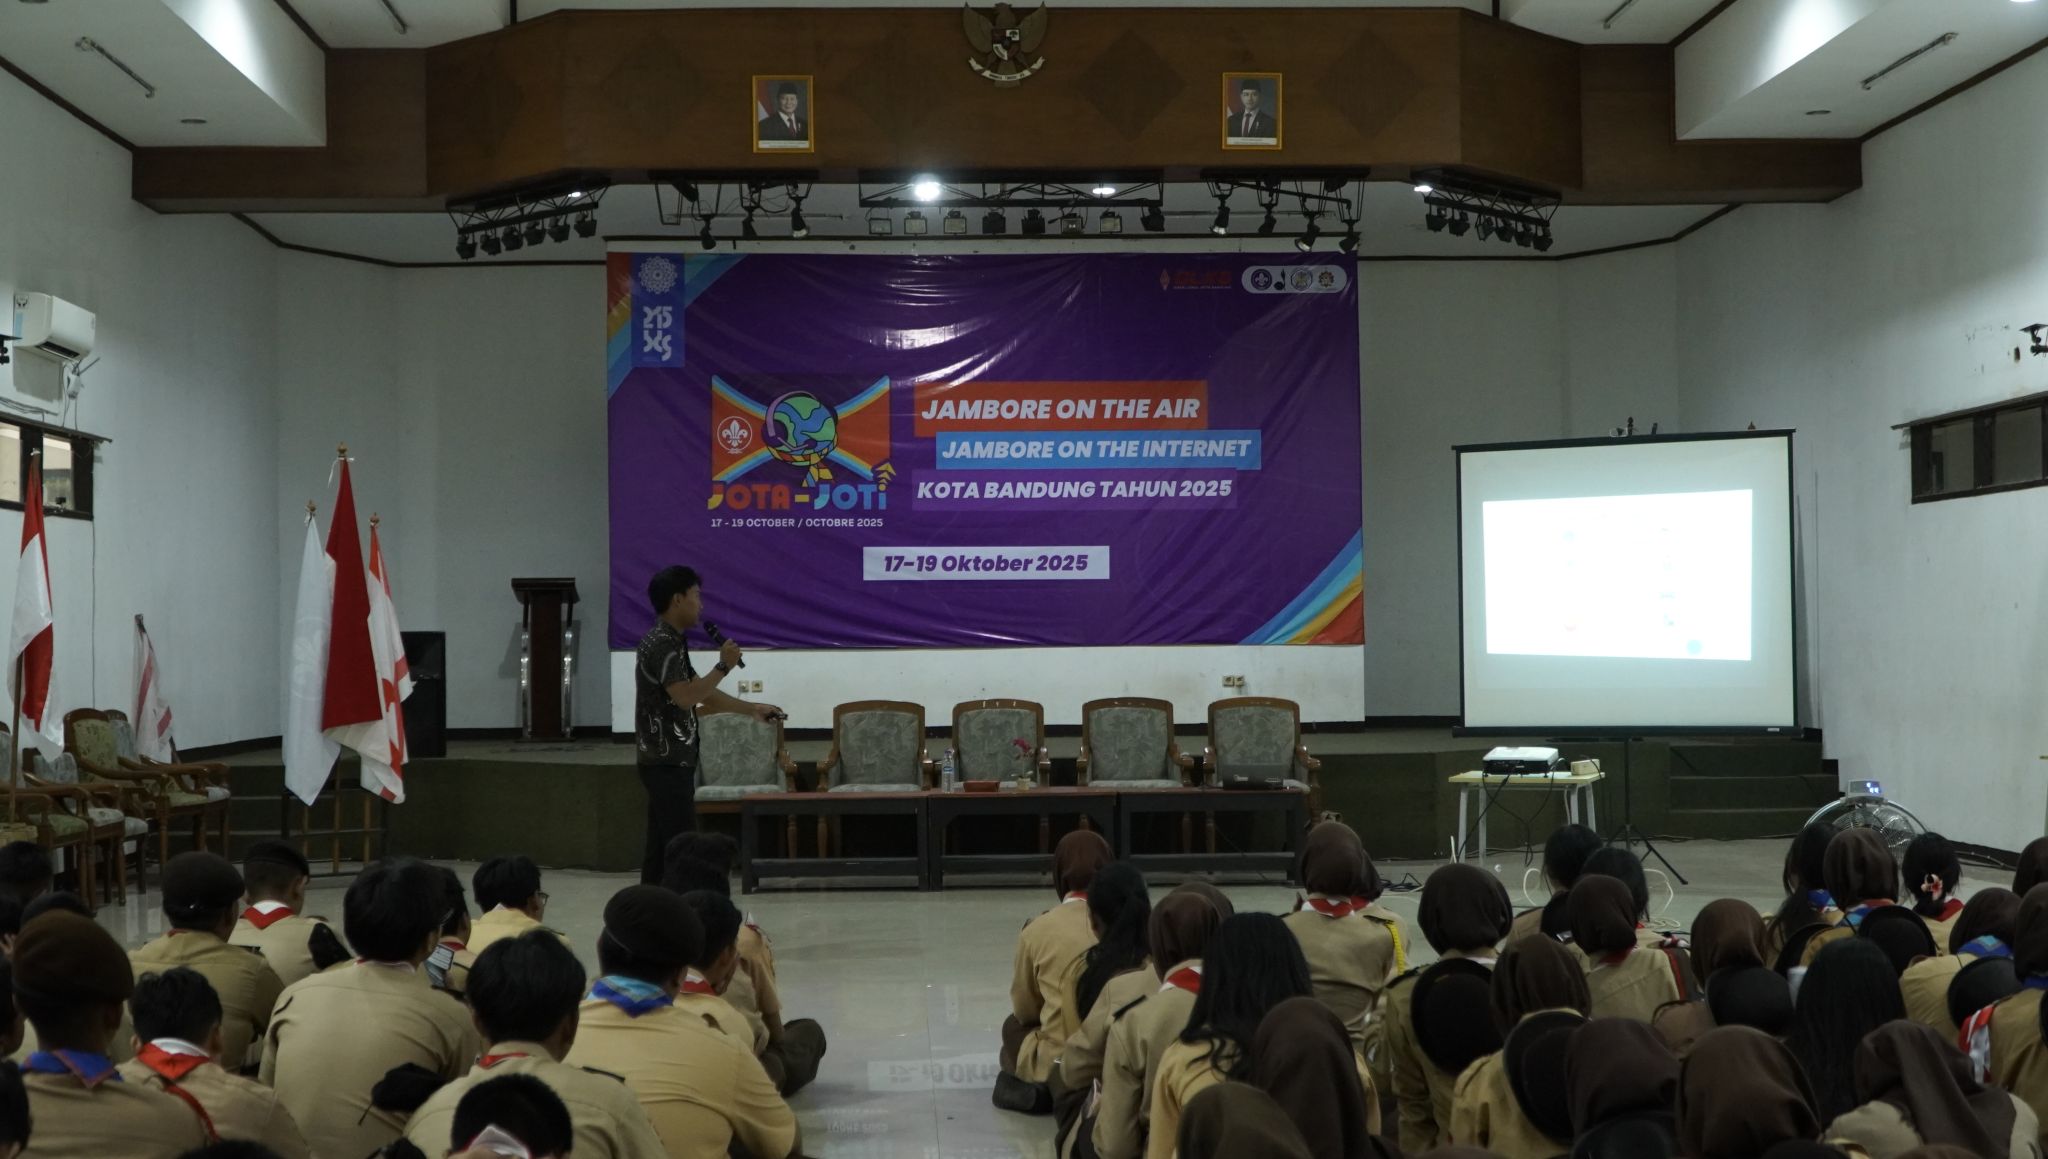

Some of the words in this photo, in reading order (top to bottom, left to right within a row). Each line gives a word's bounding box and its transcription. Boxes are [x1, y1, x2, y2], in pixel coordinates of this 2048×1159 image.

[921, 399, 1053, 420] JAMBORE
[1056, 399, 1098, 419] ON
[1101, 399, 1152, 419] THE
[1153, 398, 1200, 419] AIR
[942, 440, 1055, 459] JAMBORE
[1058, 440, 1094, 458] ON
[1097, 440, 1140, 458] THE
[1142, 439, 1252, 458] INTERNET
[917, 480, 981, 499] KOTA
[983, 480, 1096, 499] BANDUNG
[1099, 479, 1178, 498] TAHUN
[1179, 478, 1233, 497] 2025
[711, 518, 723, 528] 17
[731, 518, 744, 527] 19
[746, 518, 795, 527] OCTOBER
[805, 518, 855, 527] OCTOBRE
[857, 518, 884, 527] 2025
[884, 554, 938, 573] 17-19
[941, 554, 1034, 573] Oktober
[1035, 553, 1090, 572] 2025
